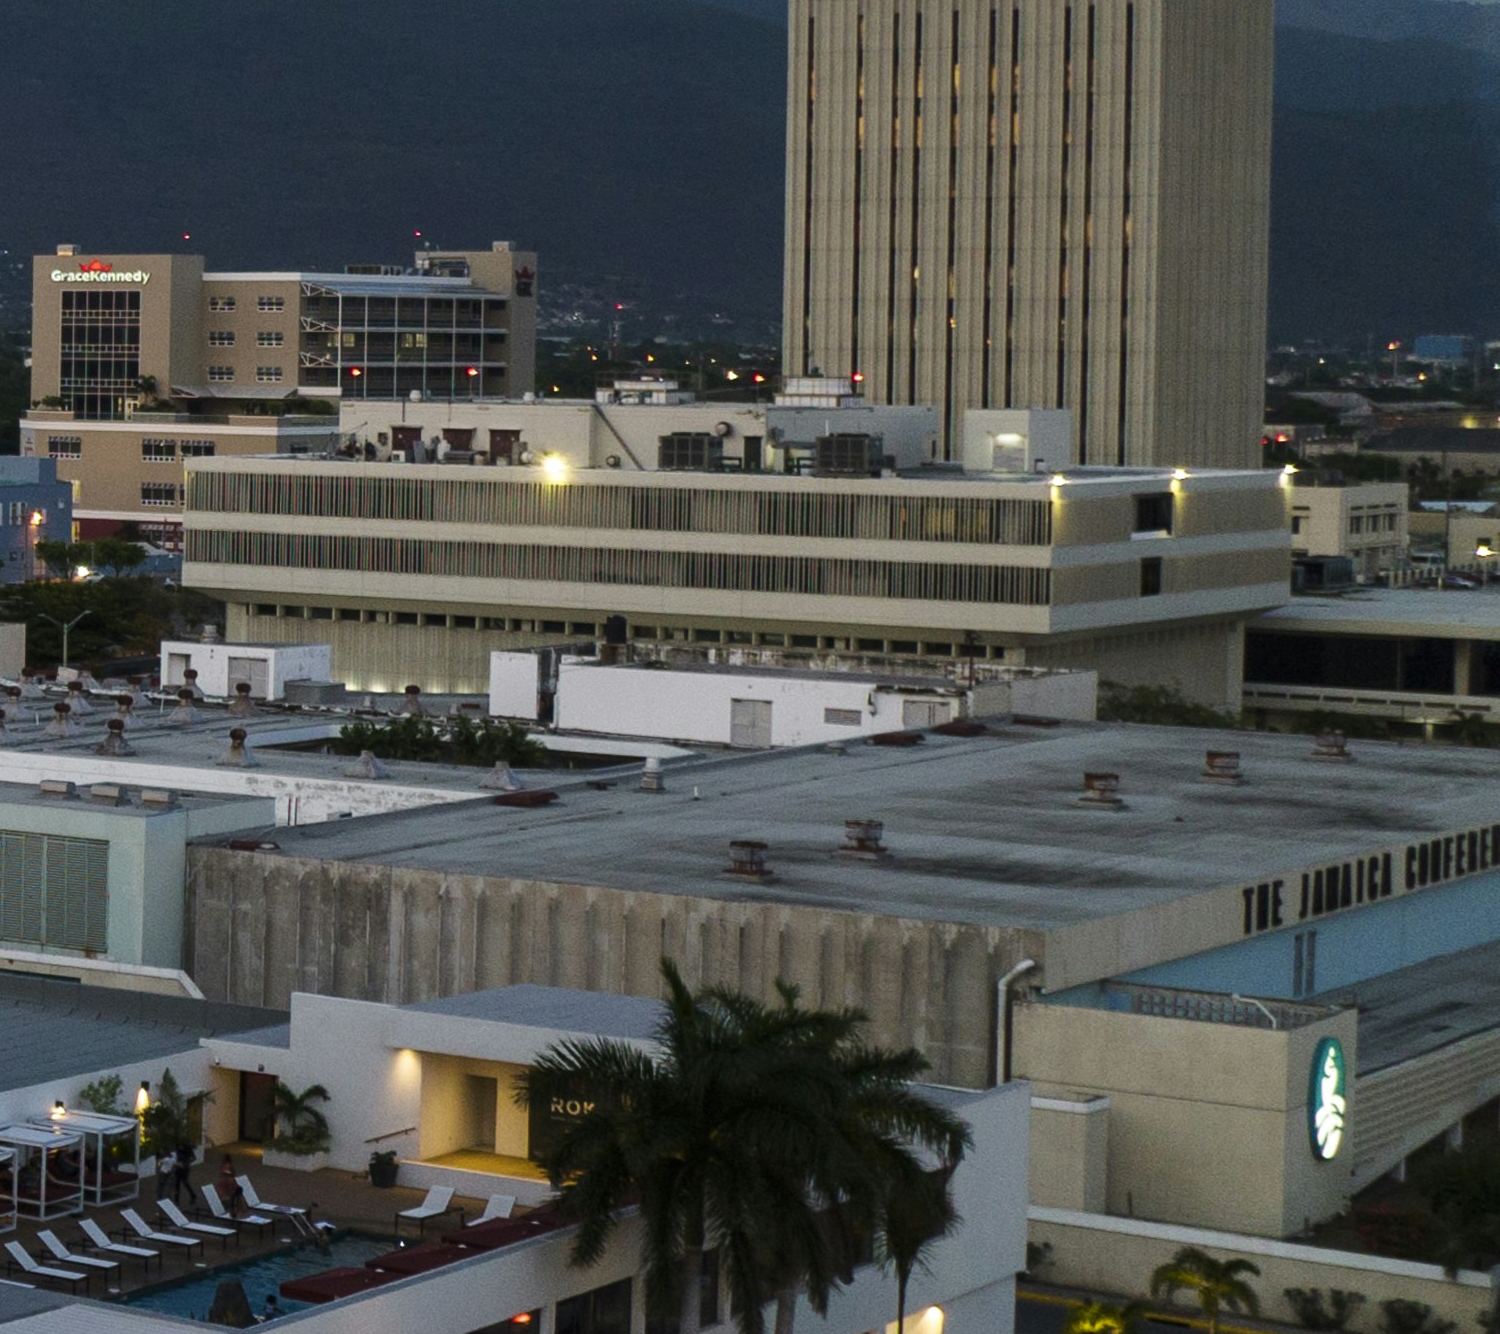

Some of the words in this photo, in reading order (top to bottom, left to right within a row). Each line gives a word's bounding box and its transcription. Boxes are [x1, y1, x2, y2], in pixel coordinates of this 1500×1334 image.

[50, 269, 151, 286] GraceKennedy
[1242, 880, 1284, 934] THE
[1298, 852, 1392, 919] JAMAICA
